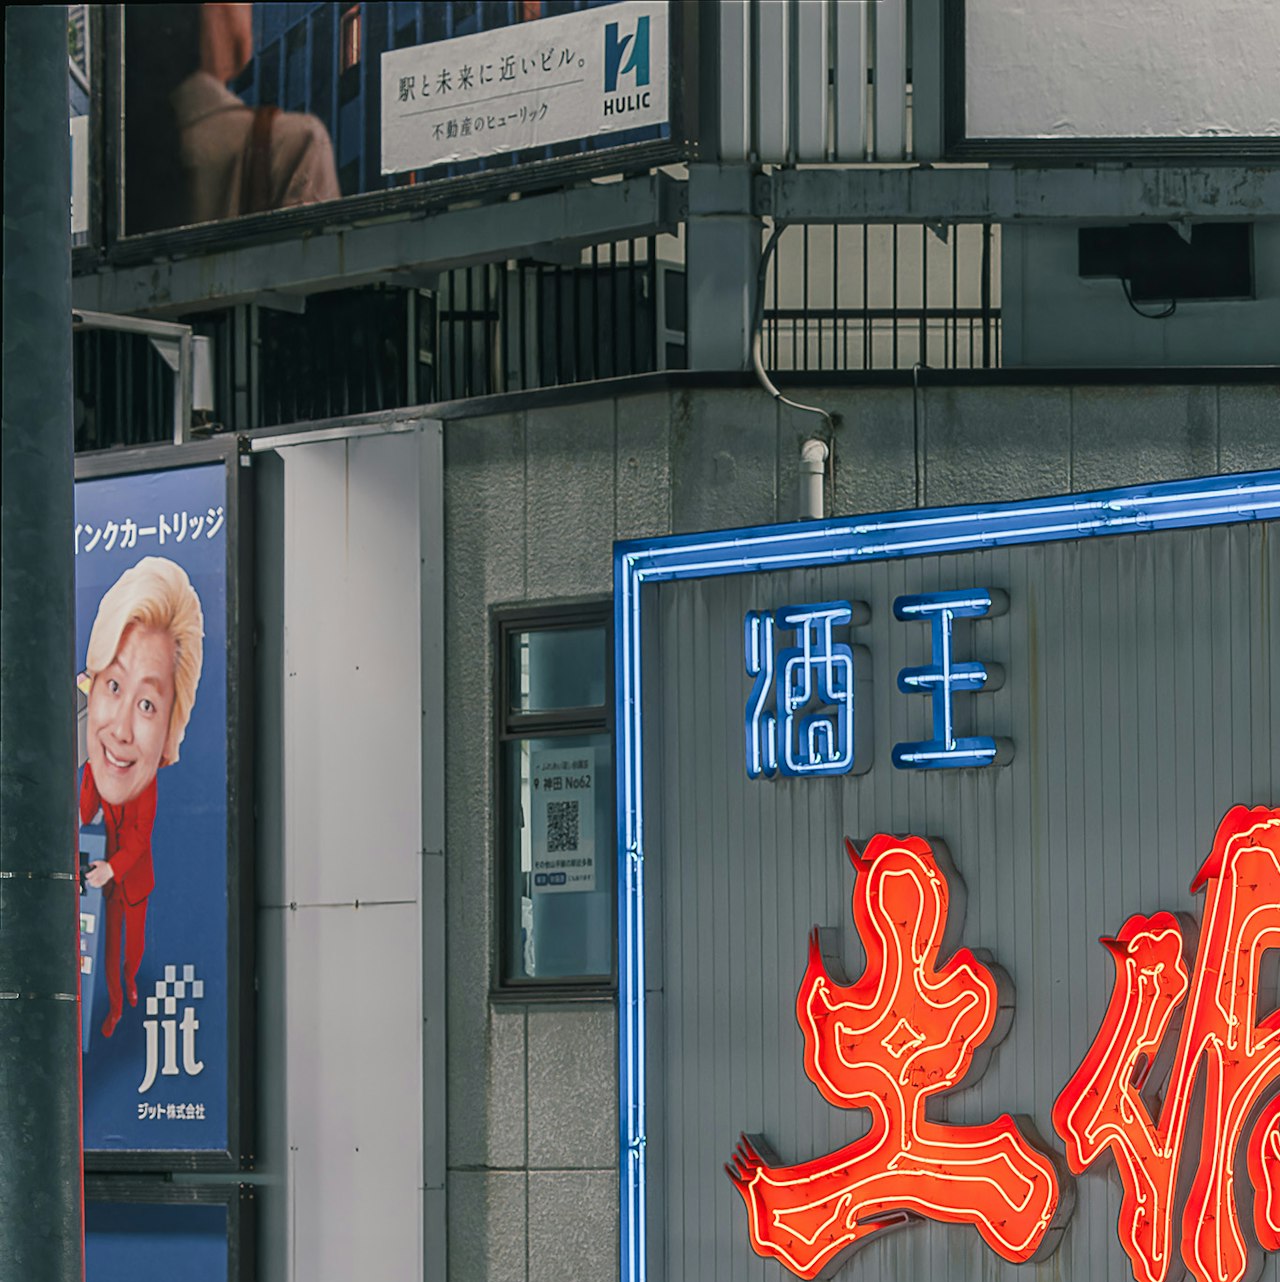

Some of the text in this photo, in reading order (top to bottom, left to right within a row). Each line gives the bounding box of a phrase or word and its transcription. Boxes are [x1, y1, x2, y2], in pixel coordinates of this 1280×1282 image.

[398, 48, 585, 102] 駅と未来に近いビル。
[431, 103, 549, 140] 不動産のヒューリック
[604, 92, 650, 116] HULIC
[745, 588, 998, 777] 酒王
[138, 1007, 204, 1093] jit
[138, 1102, 206, 1120] ジット株式会社
